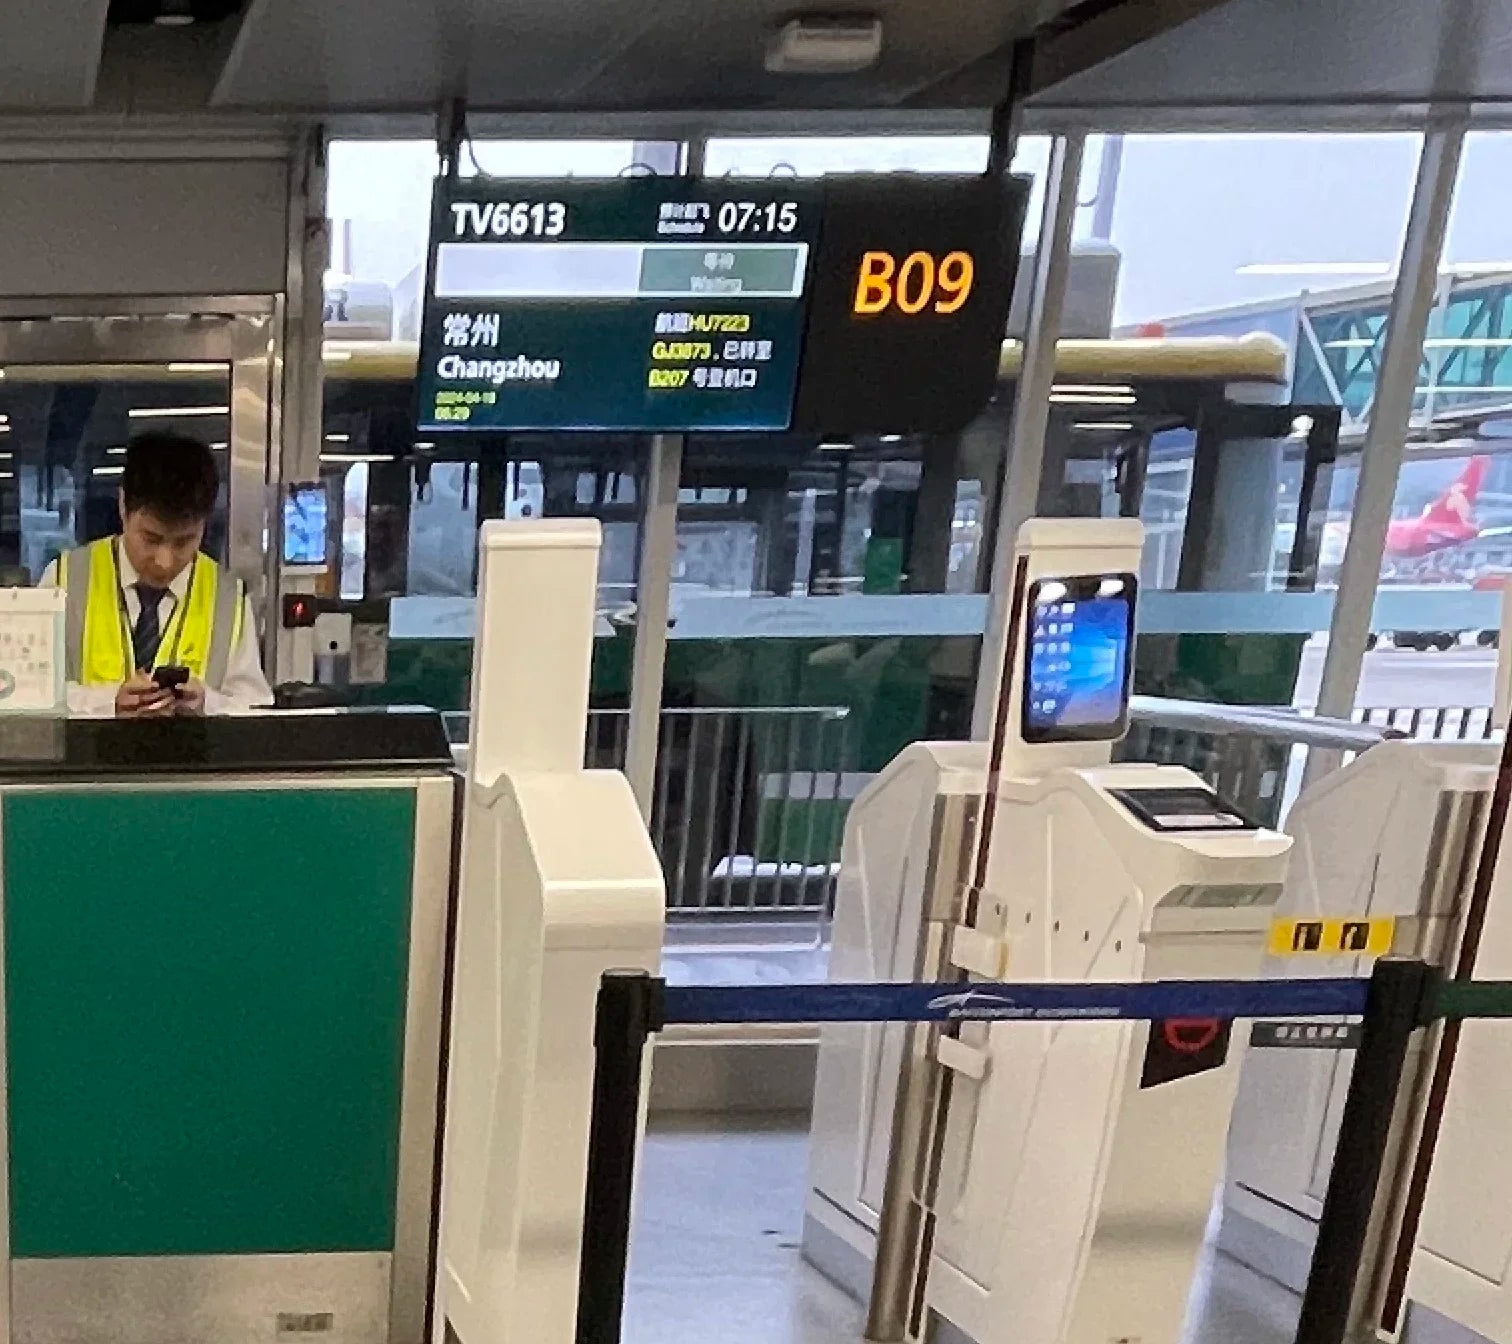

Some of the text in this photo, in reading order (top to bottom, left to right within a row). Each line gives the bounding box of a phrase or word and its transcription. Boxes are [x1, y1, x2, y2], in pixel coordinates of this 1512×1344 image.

[450, 201, 566, 236] TV6613
[717, 201, 798, 233] 07:15
[853, 250, 975, 314] B09
[442, 312, 501, 348] 常州
[437, 353, 562, 385] Changzhou
